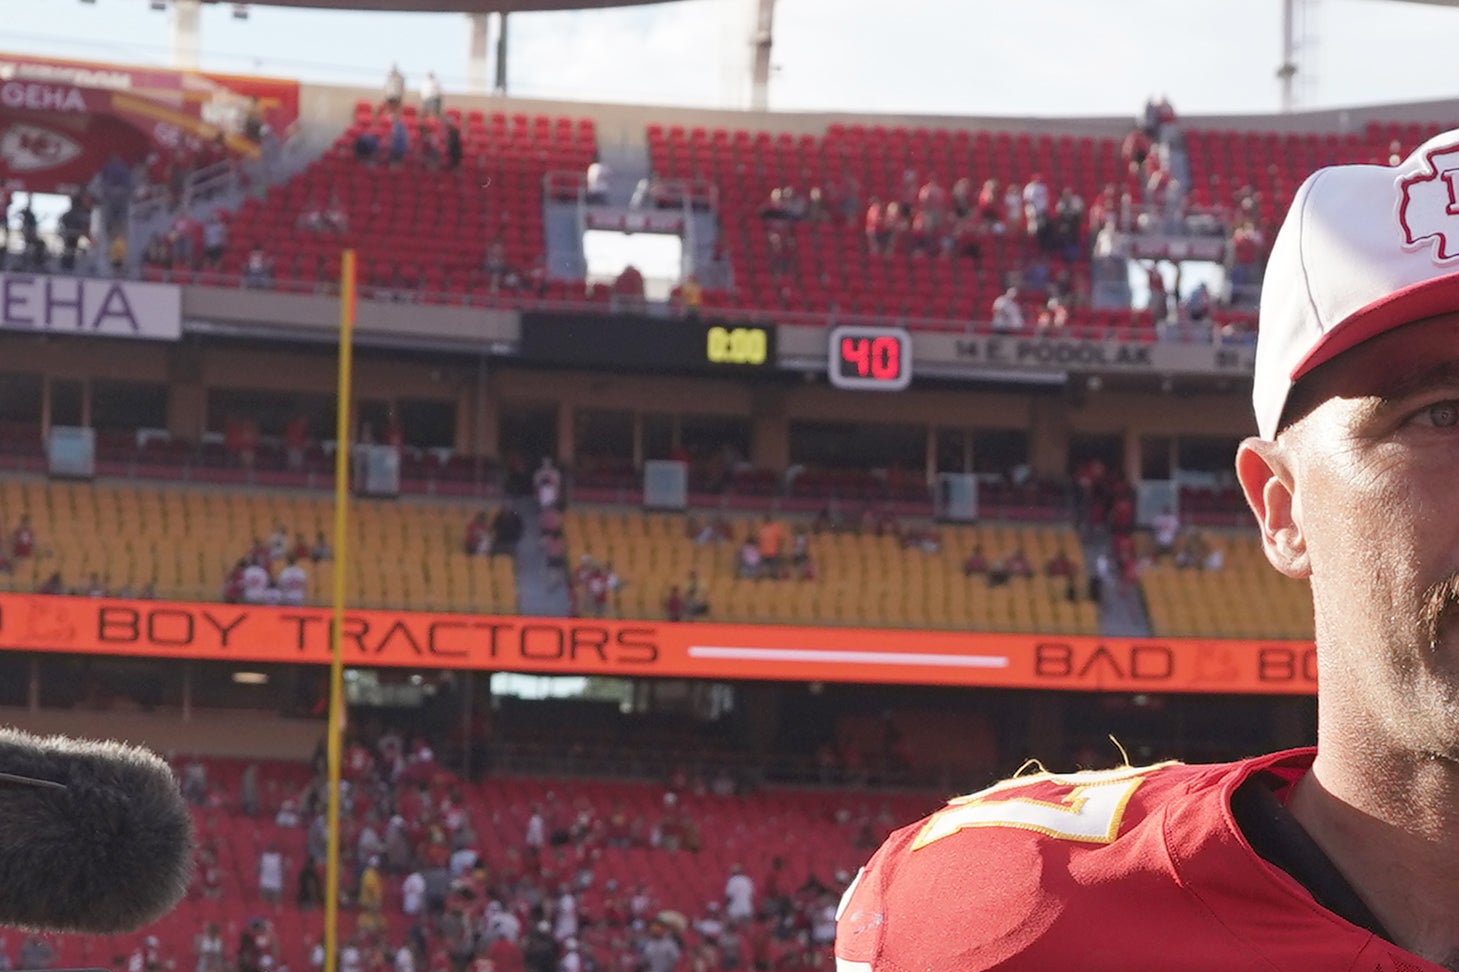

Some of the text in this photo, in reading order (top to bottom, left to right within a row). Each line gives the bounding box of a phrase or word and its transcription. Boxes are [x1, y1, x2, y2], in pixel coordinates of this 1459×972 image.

[3, 276, 139, 331] EHA
[841, 336, 899, 380] 40
[1017, 340, 1152, 364] PODOLAK
[98, 607, 659, 664] BOY TRACTORS
[1034, 643, 1175, 681] BAD
